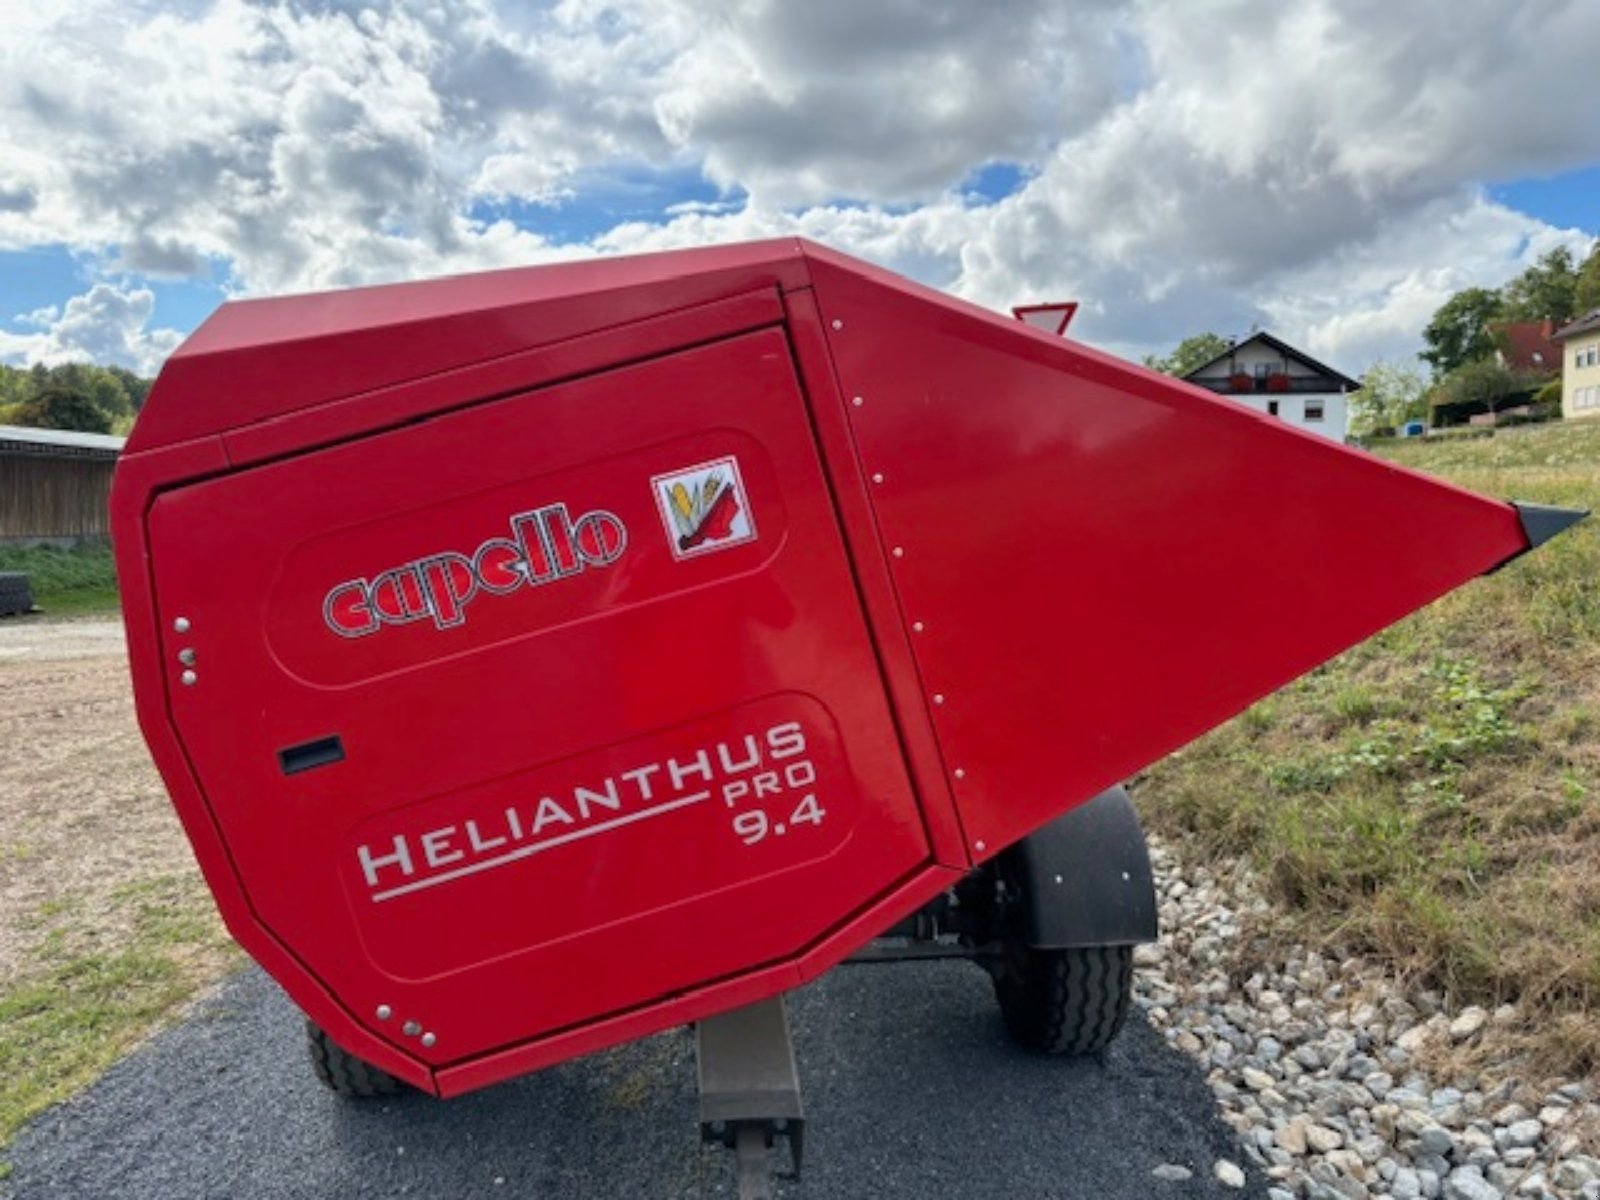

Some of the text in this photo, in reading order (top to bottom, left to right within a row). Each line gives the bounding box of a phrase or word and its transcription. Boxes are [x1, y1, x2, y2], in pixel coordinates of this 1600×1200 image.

[323, 502, 628, 638] capello
[356, 721, 806, 886] HELIANTHUS
[722, 760, 816, 808] PRO
[732, 794, 827, 846] 9.4
